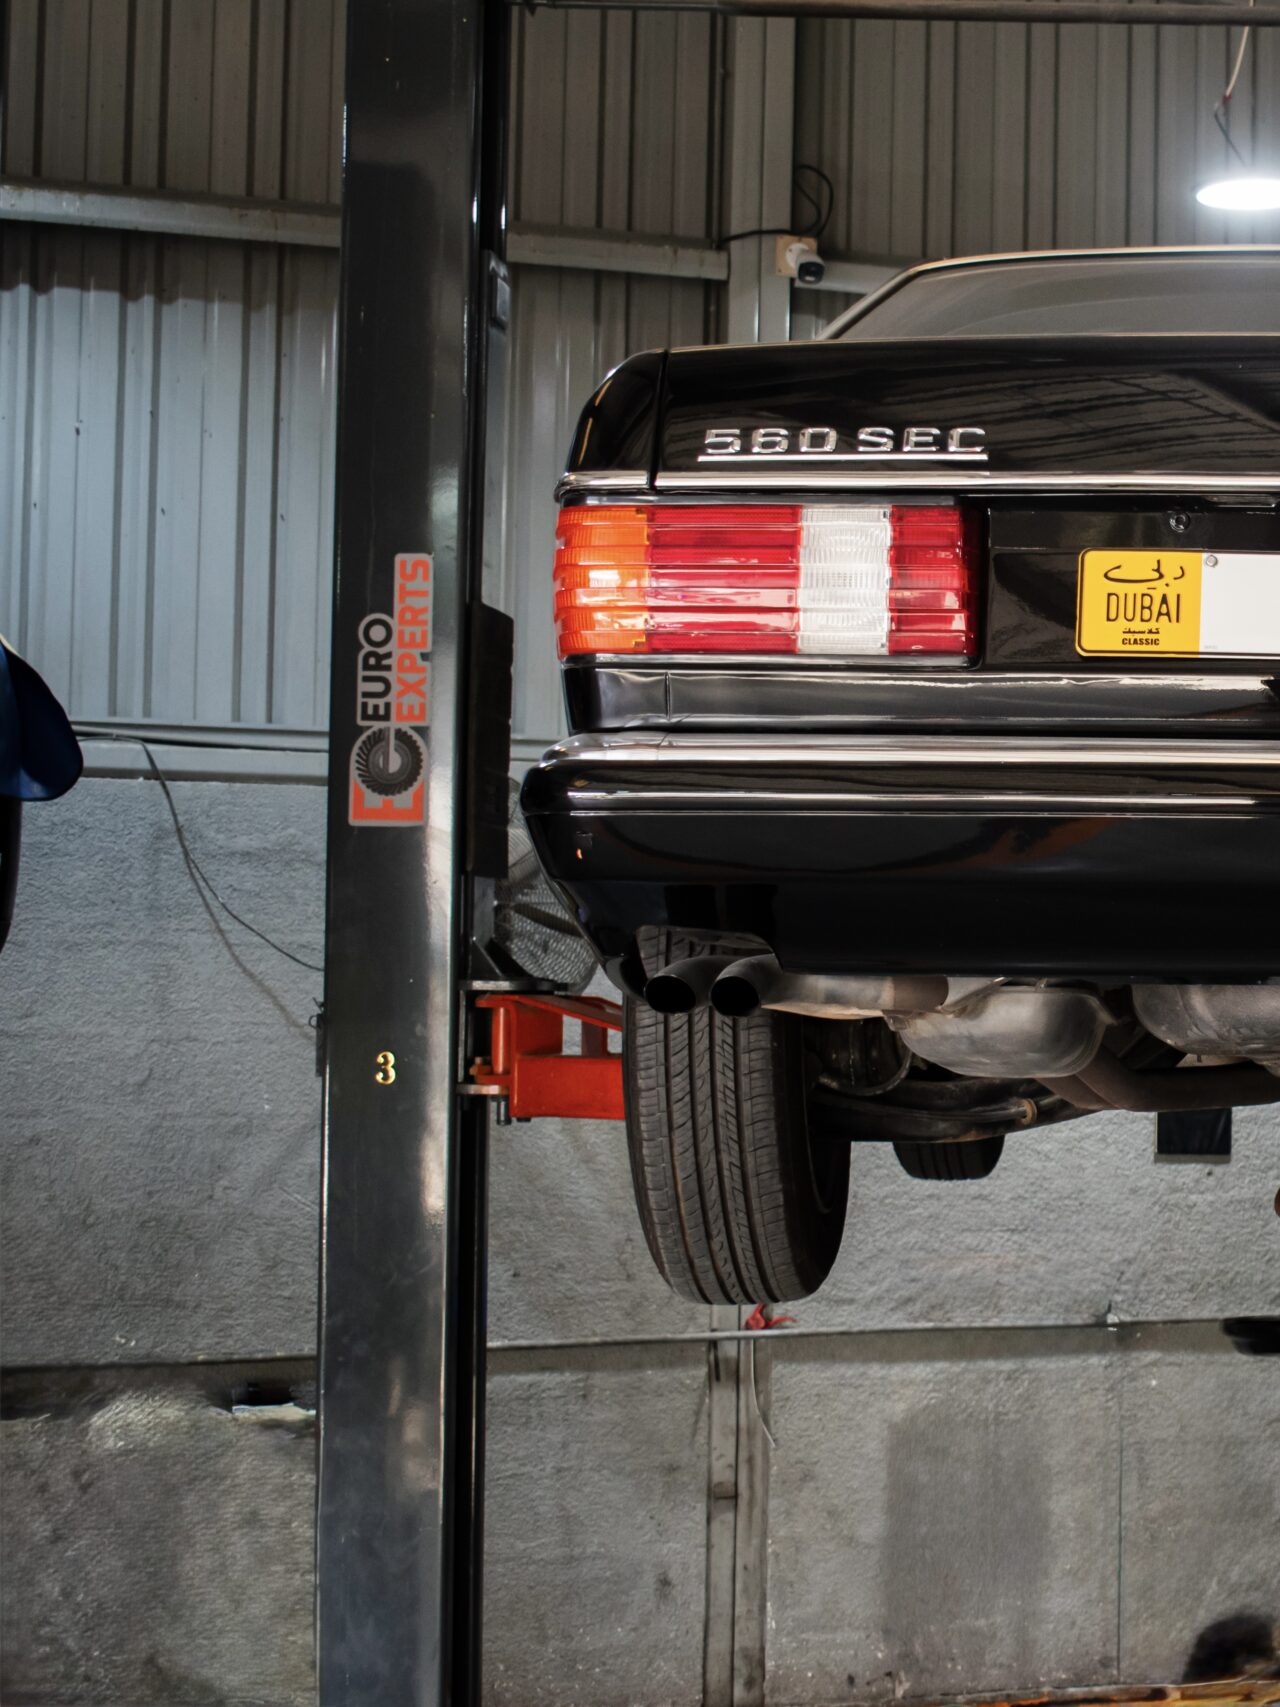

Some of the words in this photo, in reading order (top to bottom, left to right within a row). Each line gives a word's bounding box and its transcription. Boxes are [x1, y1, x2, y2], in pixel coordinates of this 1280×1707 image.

[704, 427, 837, 454] 560
[857, 426, 986, 453] SEC
[1106, 592, 1181, 623] DUBAI
[395, 558, 430, 723] EXPERTS
[1122, 637, 1160, 646] CLASSIC
[361, 617, 393, 722] EURO
[376, 1051, 396, 1085] 3
